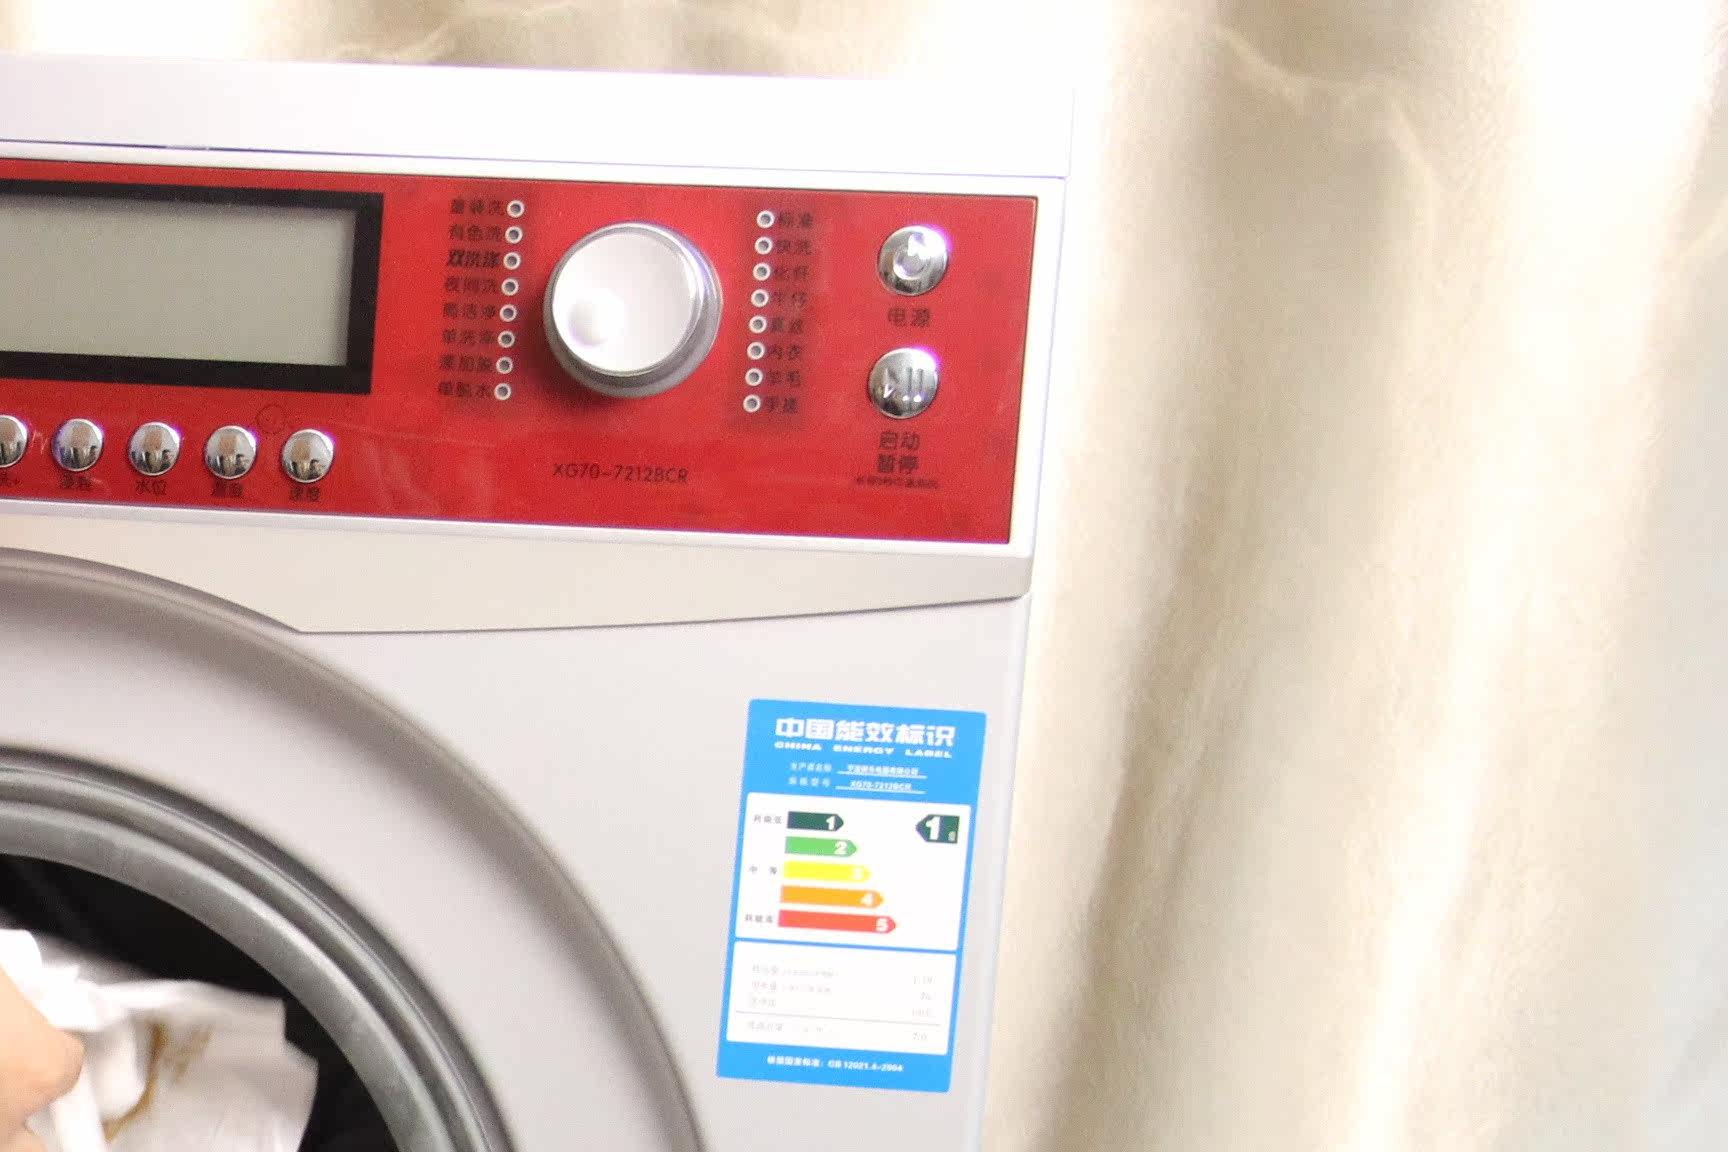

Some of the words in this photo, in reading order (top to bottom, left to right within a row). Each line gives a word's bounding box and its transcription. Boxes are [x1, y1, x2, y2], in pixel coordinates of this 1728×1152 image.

[887, 307, 930, 328] 电源
[879, 430, 921, 451] 启动
[552, 462, 689, 484] XG70-7212BCR
[877, 453, 919, 475] 暂停
[135, 478, 167, 496] 水位
[774, 716, 957, 747] 中国能效标识
[774, 741, 822, 751] CHINA
[832, 744, 895, 756] ENERGY
[904, 748, 953, 759] LABEL
[825, 815, 837, 831] 1
[925, 816, 942, 842] 1
[834, 840, 848, 856] 2
[860, 893, 874, 907] 4
[875, 917, 890, 933] 5
